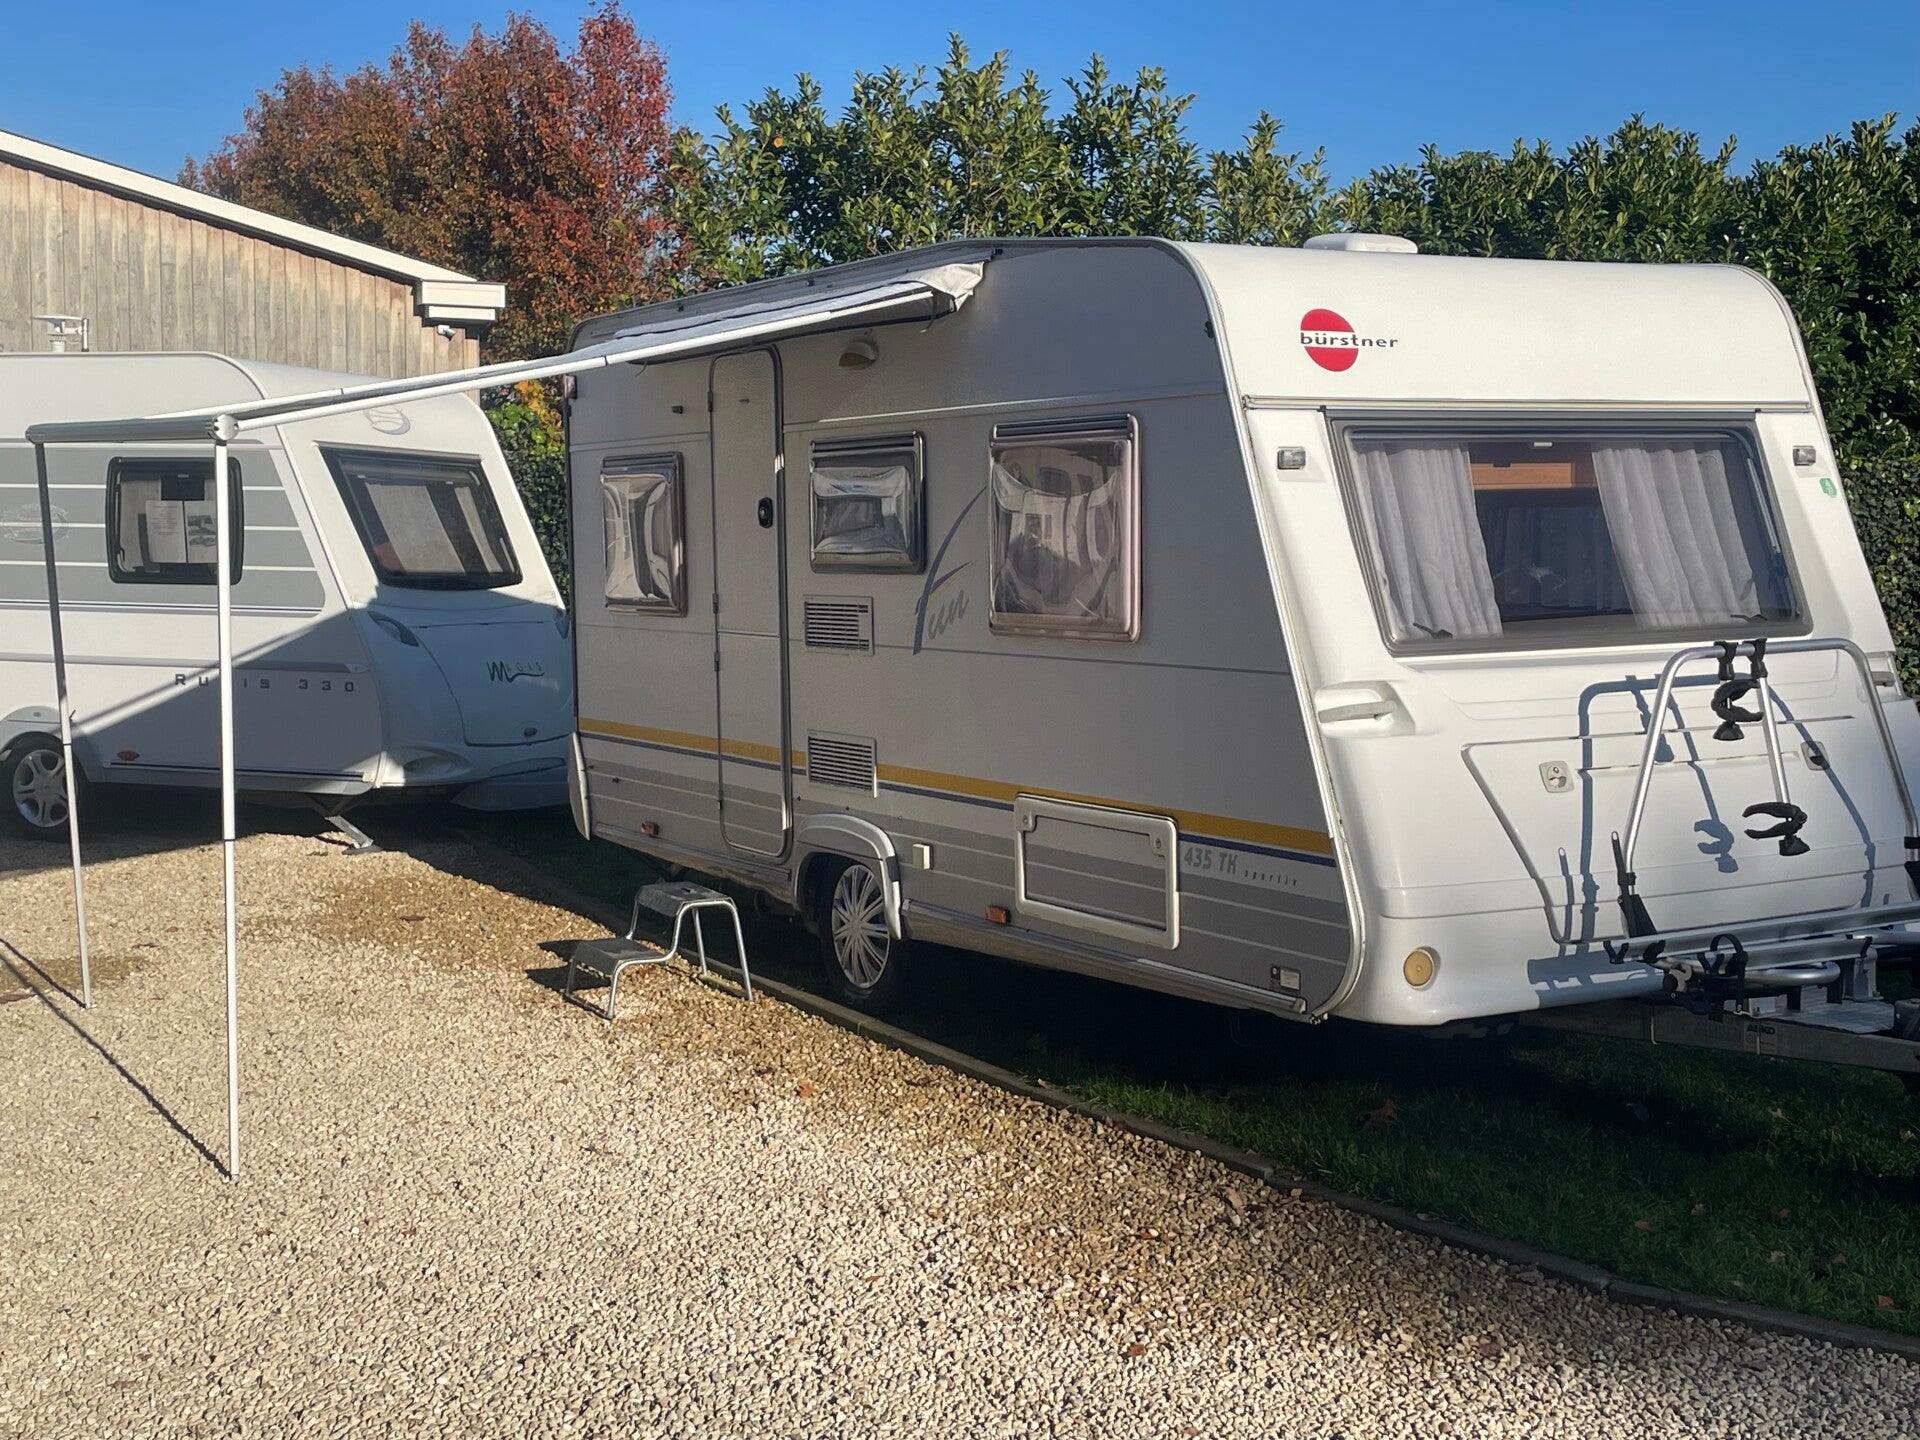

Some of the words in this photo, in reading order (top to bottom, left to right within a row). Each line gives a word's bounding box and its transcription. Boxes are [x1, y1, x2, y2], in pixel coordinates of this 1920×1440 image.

[1300, 332, 1399, 348] bürstner
[912, 484, 988, 656] Fun
[175, 673, 270, 689] RUIS
[299, 679, 355, 693] 330
[1184, 846, 1213, 870] 435
[1219, 851, 1239, 875] TK
